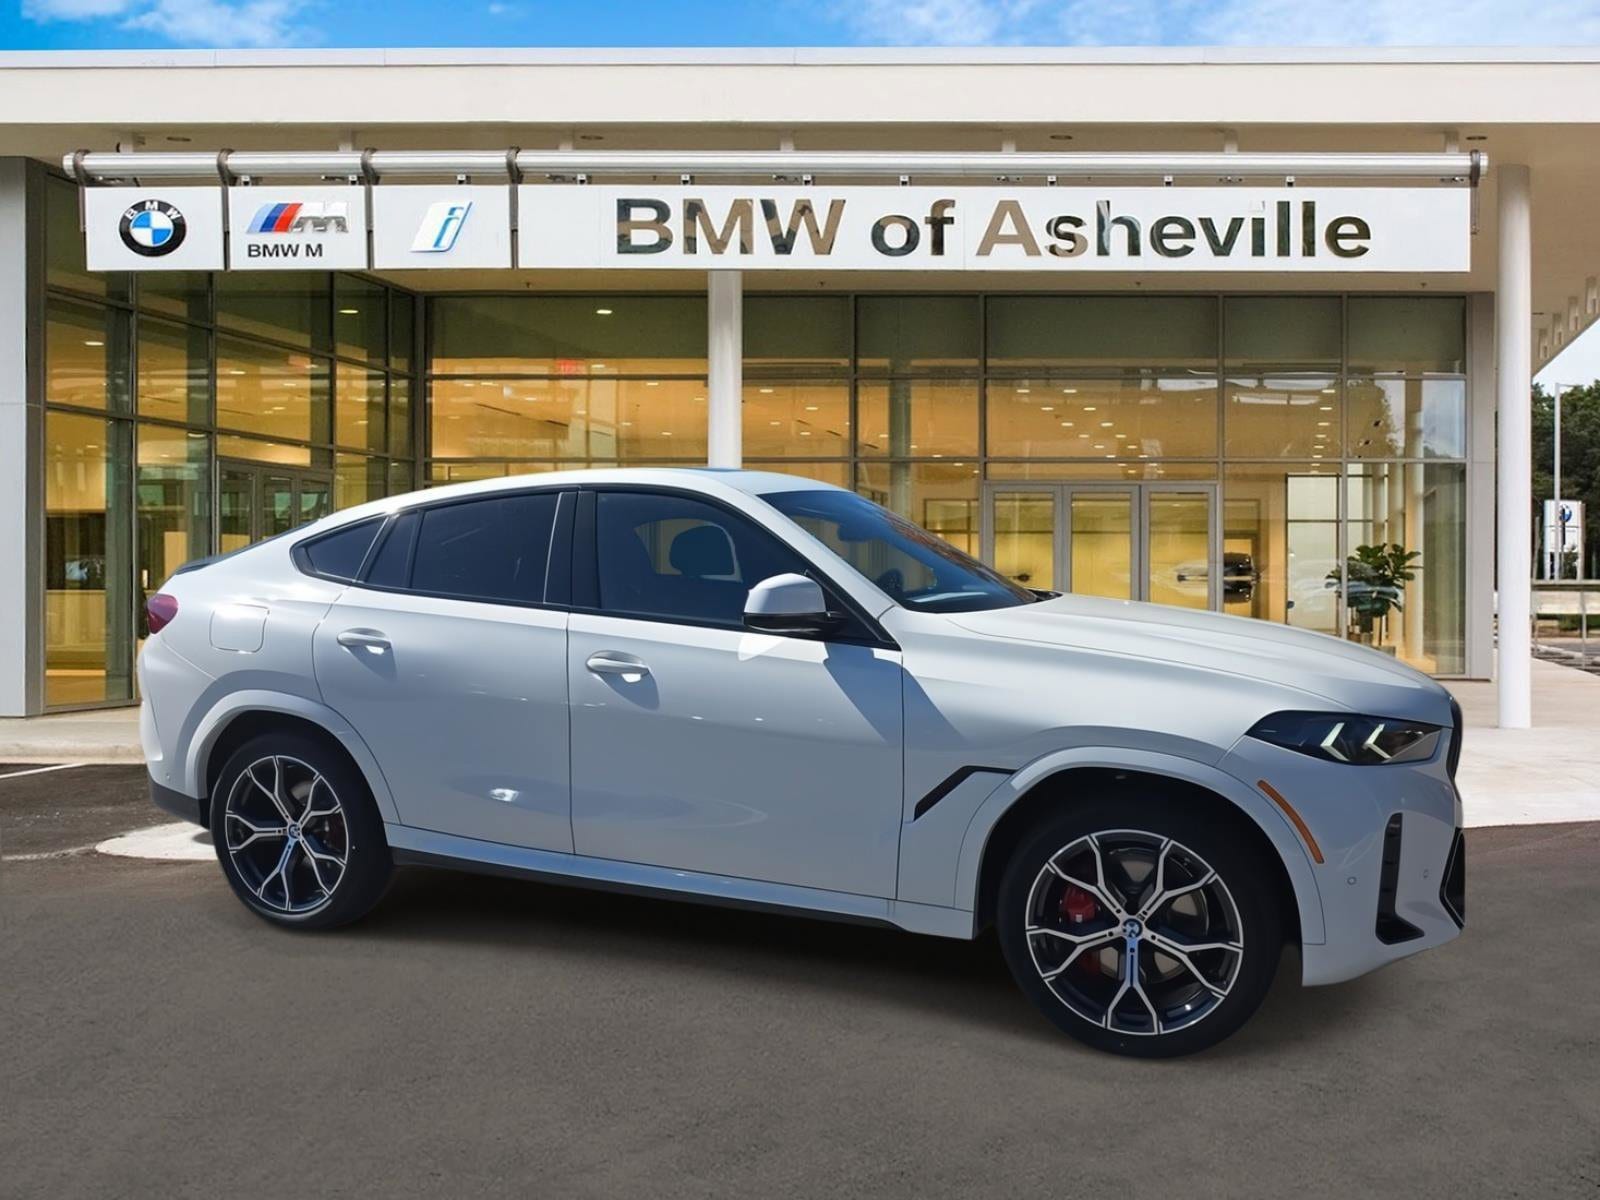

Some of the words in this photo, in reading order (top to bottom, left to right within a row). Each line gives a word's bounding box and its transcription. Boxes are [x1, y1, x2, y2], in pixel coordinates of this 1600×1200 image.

[125, 201, 182, 220] BMW
[616, 198, 846, 256] BMW
[870, 199, 955, 257] of
[975, 199, 1372, 258] Asheville
[247, 243, 300, 258] BMW
[305, 243, 323, 258] M
